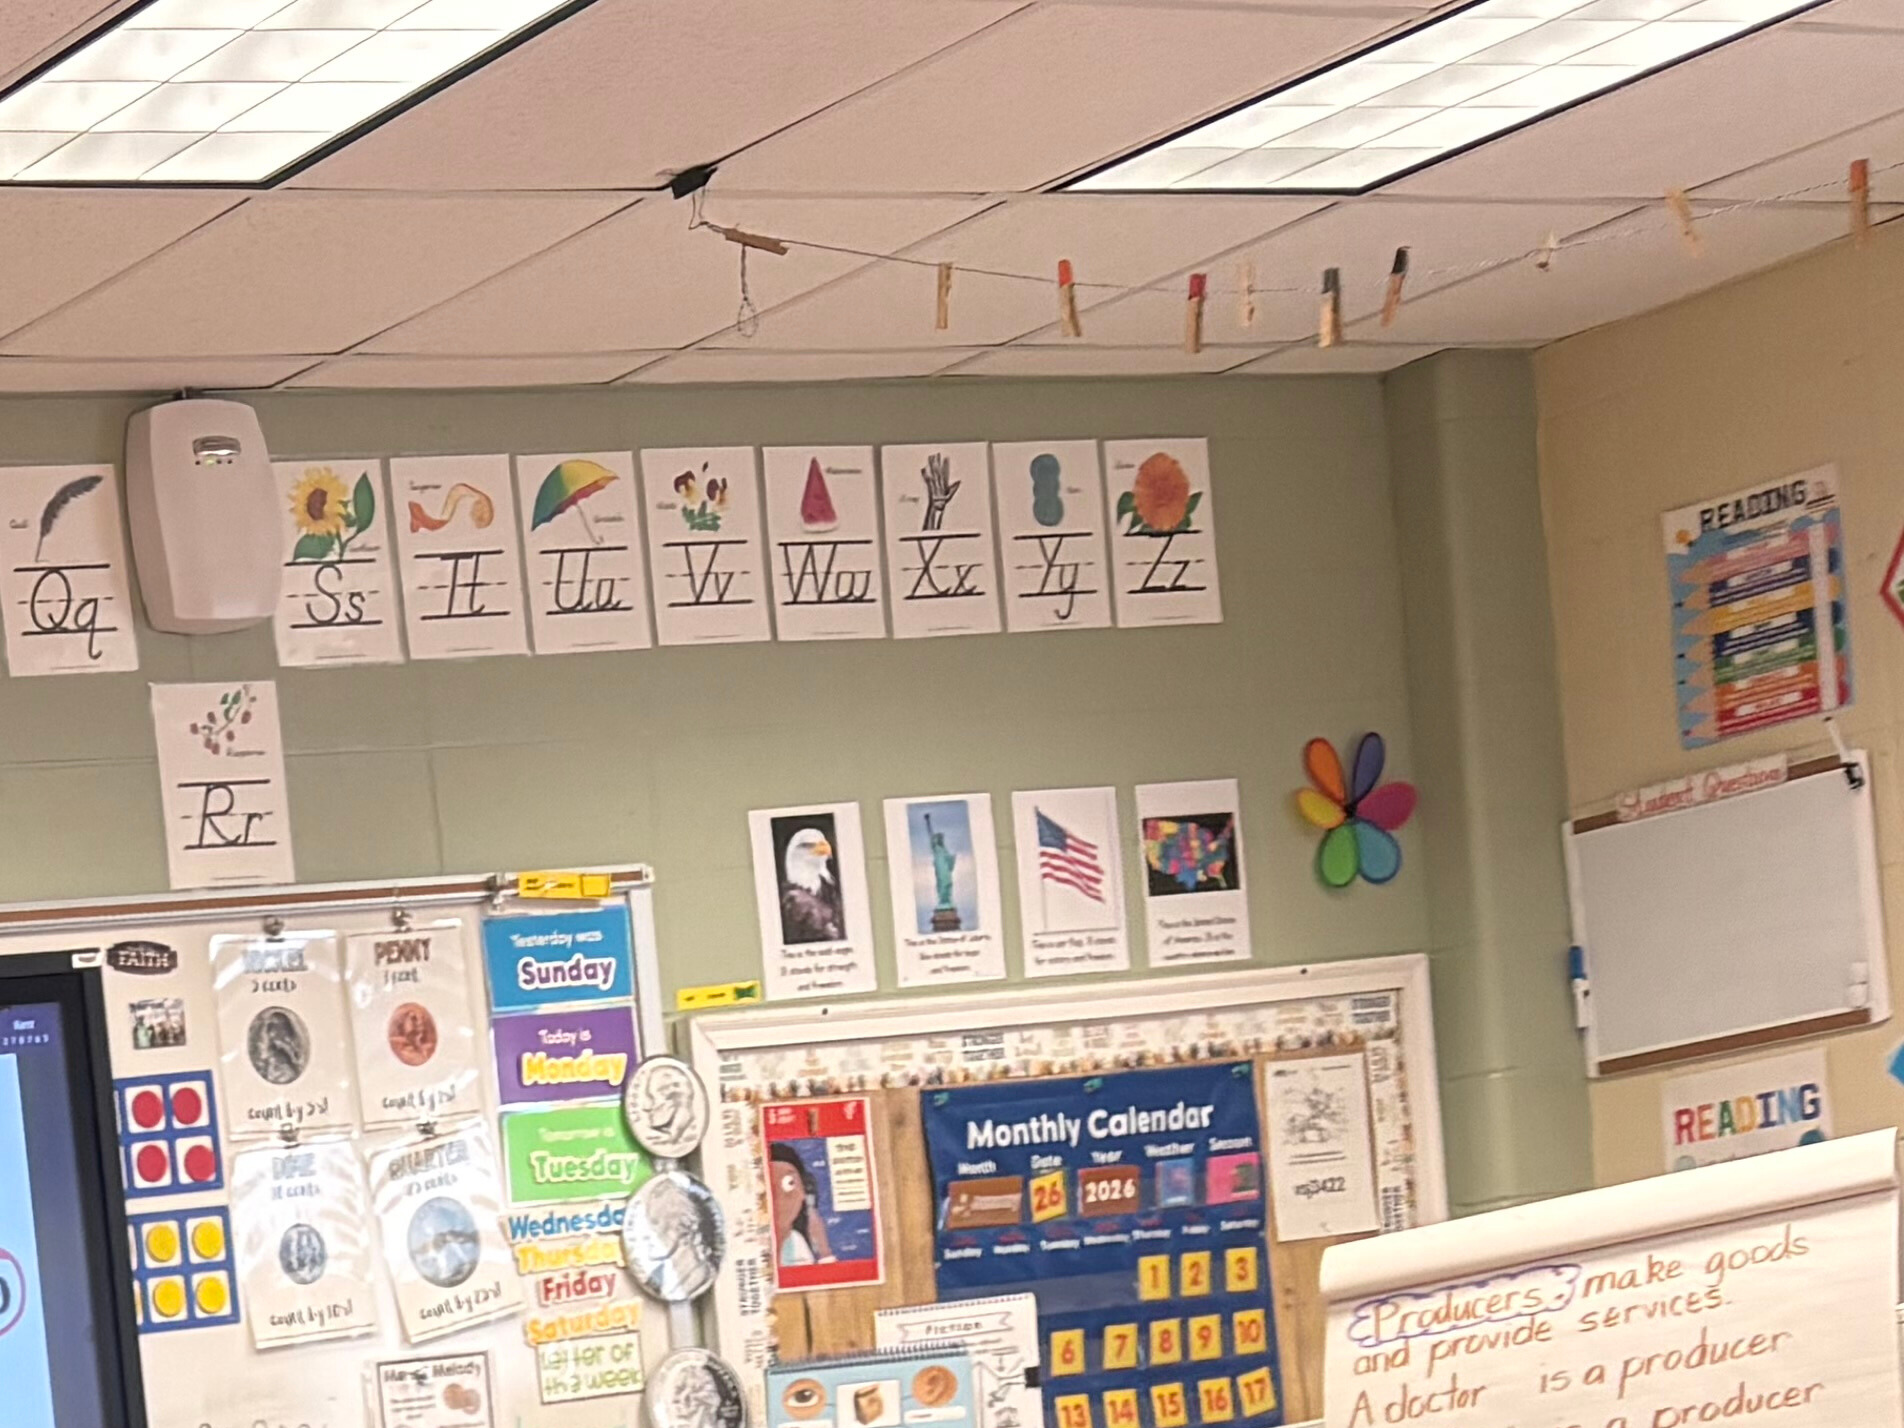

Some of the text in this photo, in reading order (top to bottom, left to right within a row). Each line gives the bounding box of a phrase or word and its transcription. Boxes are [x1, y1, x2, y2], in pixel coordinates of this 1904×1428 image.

[1700, 480, 1807, 531] READING
[439, 553, 488, 616] Tt
[684, 543, 733, 604] Vv
[779, 542, 871, 602] Ww
[908, 536, 977, 598] Xx
[1038, 535, 1079, 619] Yy
[1137, 533, 1189, 591] Zz
[29, 569, 103, 659] Qq
[304, 563, 366, 625] Ss
[197, 784, 267, 846] Rr
[520, 955, 615, 990] Sunday
[521, 1048, 627, 1087] Monday
[966, 1101, 1214, 1151] Monthly Calendar
[1674, 1082, 1822, 1145] READING
[530, 1148, 639, 1185] Tuesday
[1033, 1176, 1136, 1211] 26 2026
[541, 1271, 617, 1304] Friday
[1582, 1255, 1682, 1301] make
[1703, 1224, 1811, 1282] goods
[527, 1301, 640, 1343] Saturday
[1353, 1346, 1411, 1376] and
[1426, 1314, 1554, 1375] provide
[1384, 1372, 1487, 1426] doctor
[1539, 1370, 1573, 1394] is
[1582, 1364, 1607, 1386] a
[1617, 1327, 1792, 1399] producer
